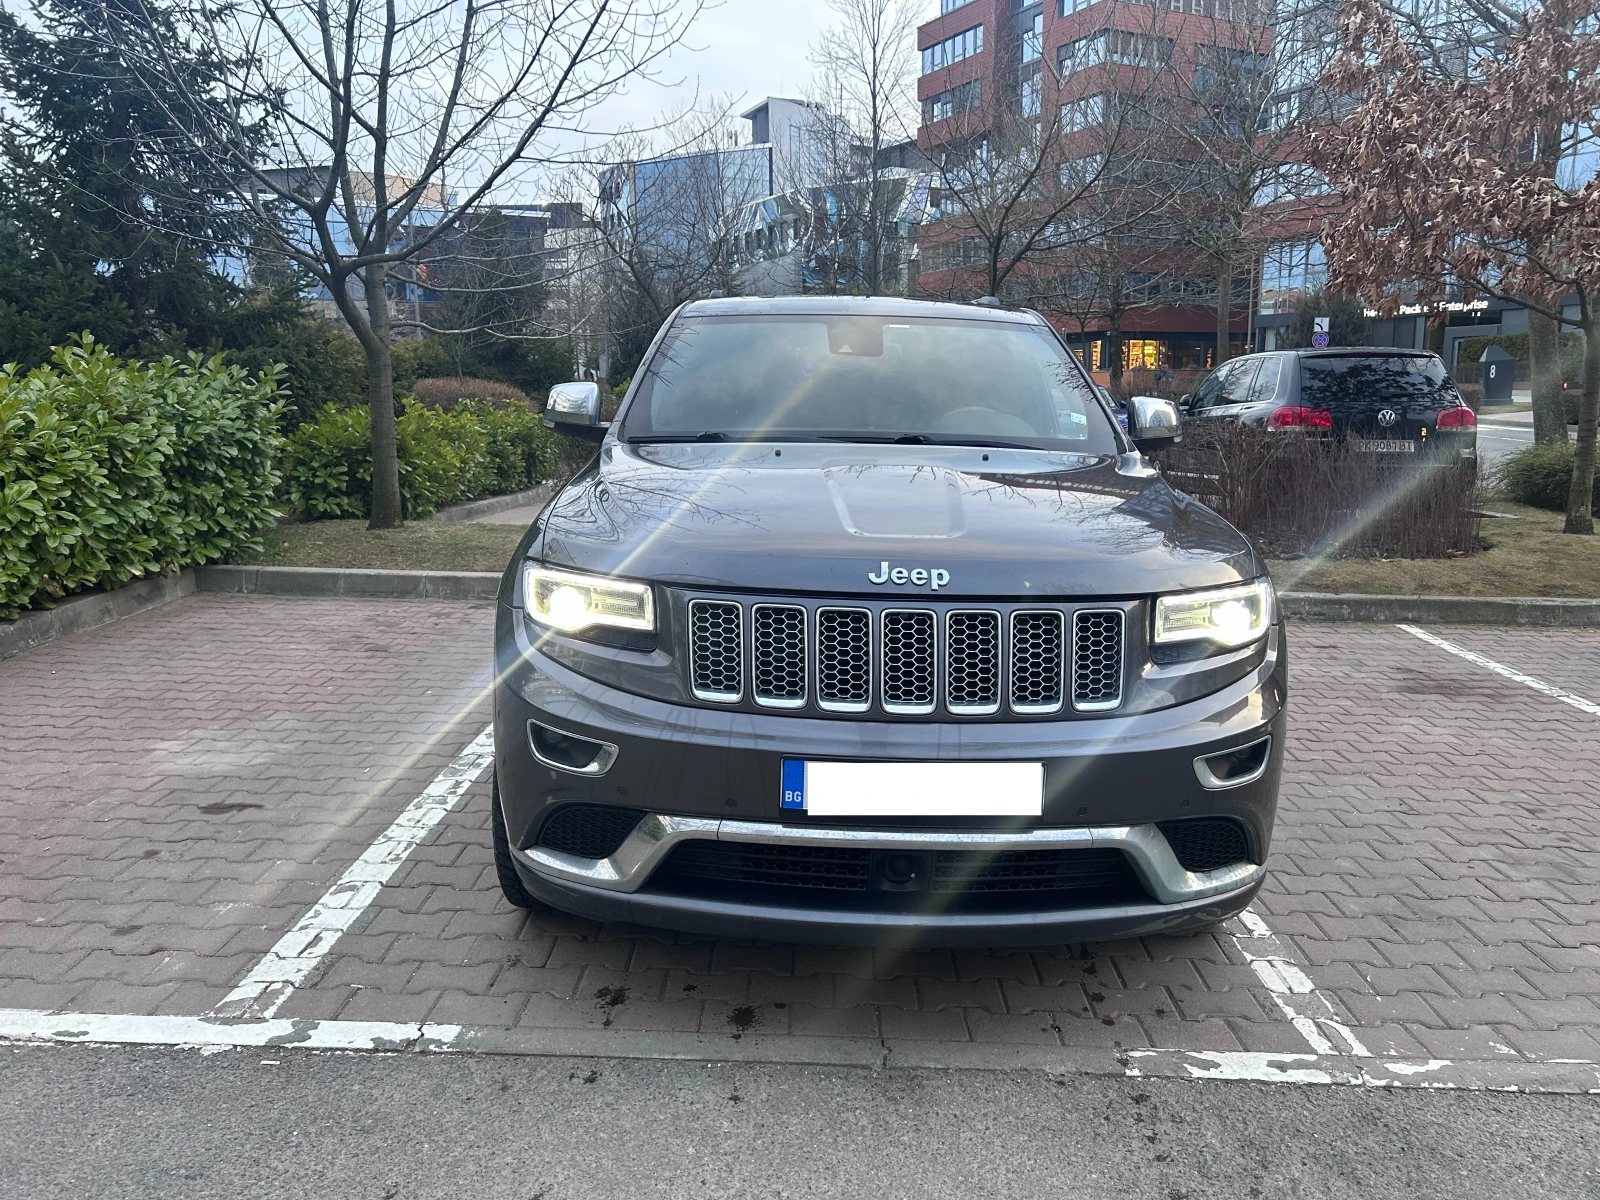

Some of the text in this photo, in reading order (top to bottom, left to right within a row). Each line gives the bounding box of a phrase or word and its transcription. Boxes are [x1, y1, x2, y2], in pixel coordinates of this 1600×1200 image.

[1399, 302, 1438, 315] Pack
[1489, 364, 1496, 379] 8
[868, 561, 950, 591] Jeep
[785, 790, 802, 803] BG
